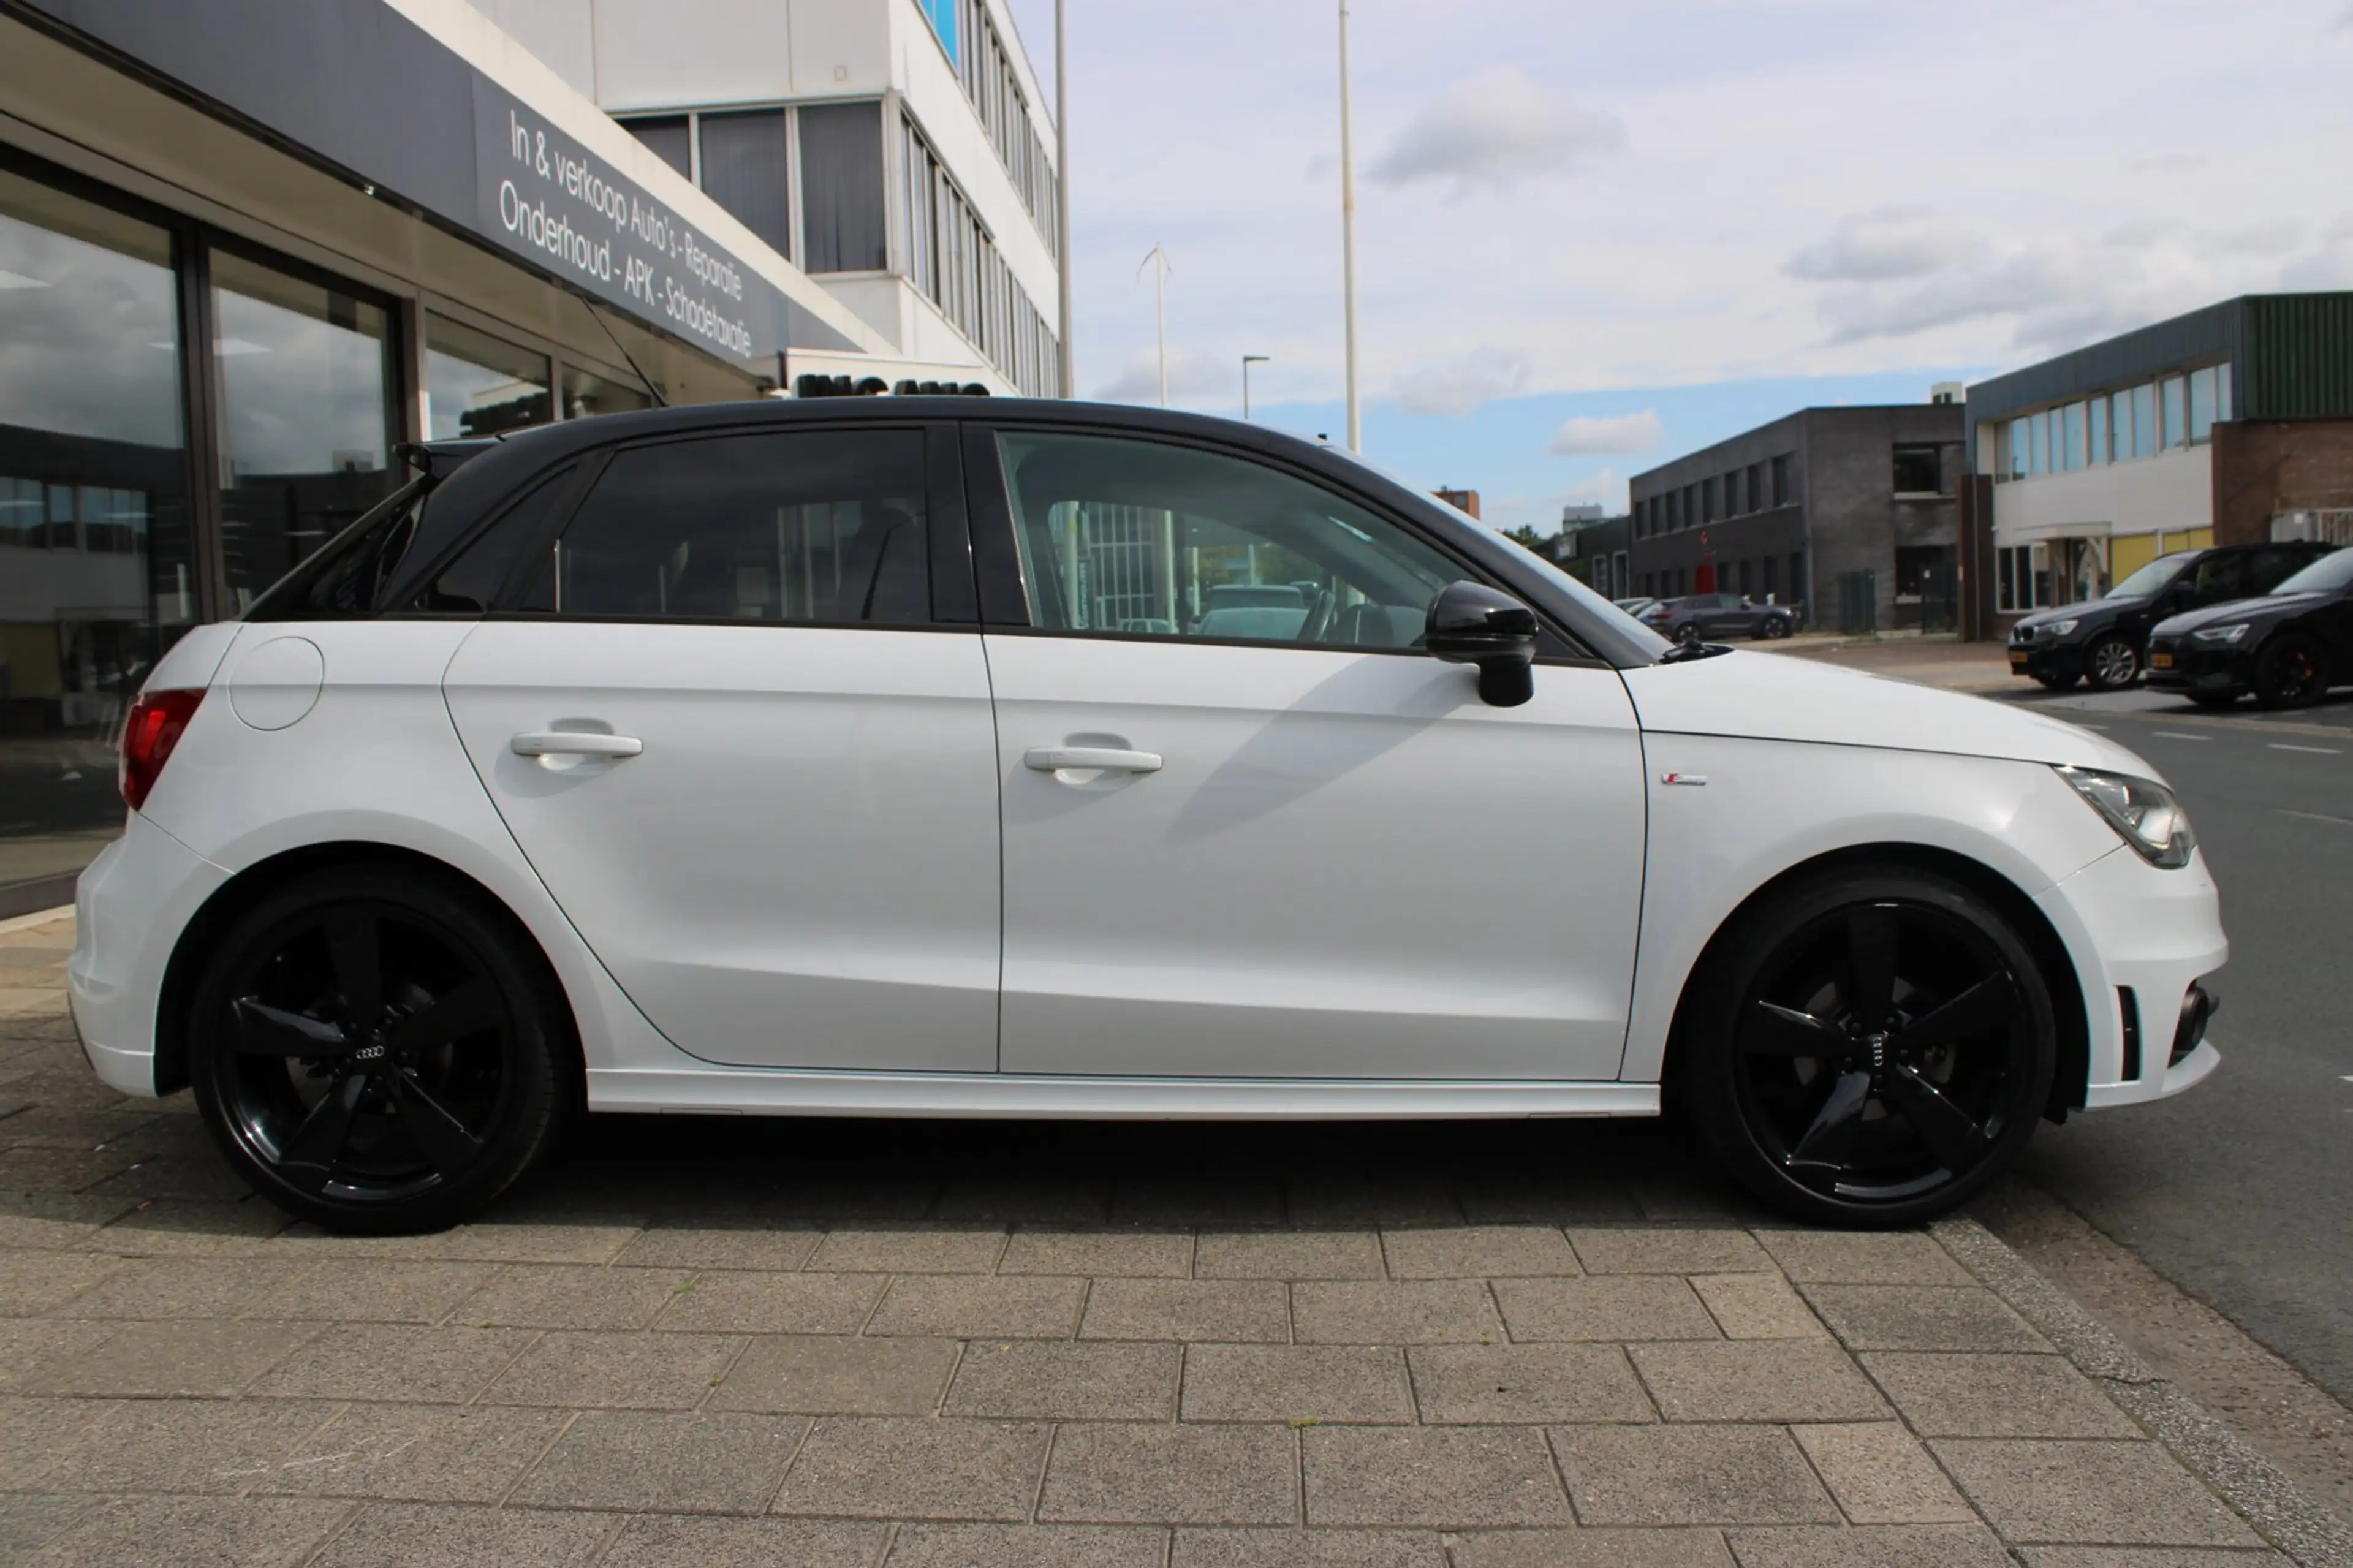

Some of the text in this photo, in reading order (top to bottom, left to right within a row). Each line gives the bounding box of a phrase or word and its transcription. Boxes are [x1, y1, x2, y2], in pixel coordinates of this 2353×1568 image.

[500, 180, 611, 282] Onderhoud
[624, 254, 655, 306] APK
[665, 276, 752, 358] Schadetaxatie
[510, 109, 530, 166] In
[536, 131, 550, 180] &
[555, 151, 627, 233] verkoop
[630, 196, 676, 259] Auto's
[684, 230, 743, 302] Reparatie
